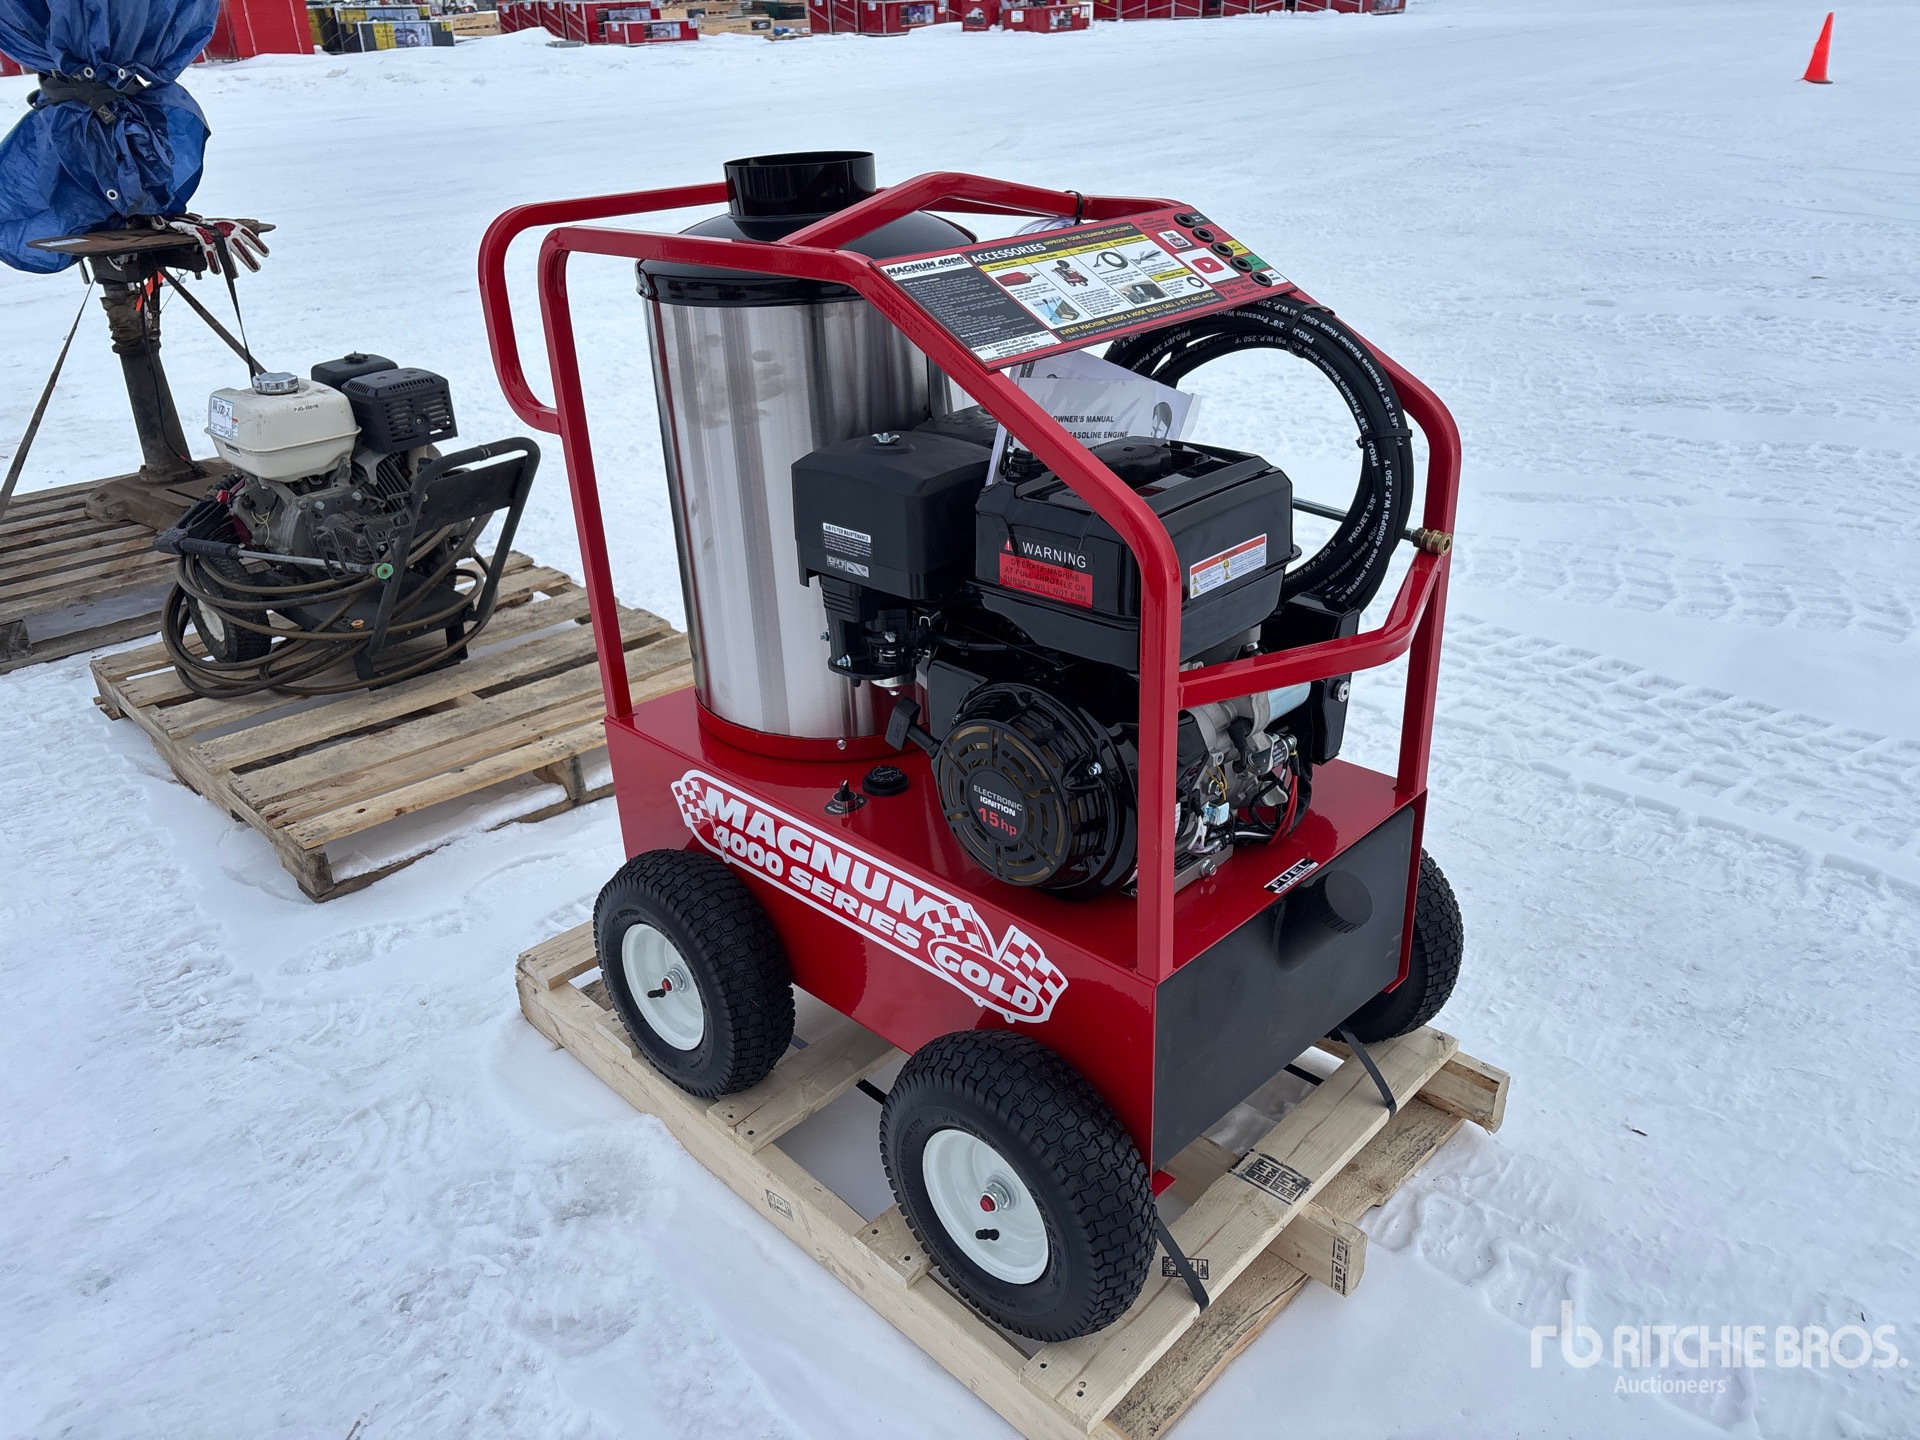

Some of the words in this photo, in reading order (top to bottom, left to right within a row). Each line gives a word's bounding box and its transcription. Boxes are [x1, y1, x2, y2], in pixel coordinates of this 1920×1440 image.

[1081, 230, 1106, 239] CLEANING
[1106, 225, 1134, 234] EFFICIENCY
[971, 243, 1046, 263] ACCESSORIES
[886, 261, 936, 275] MAGNUM
[938, 256, 965, 266] 4000
[1060, 327, 1080, 335] EVERY
[1080, 320, 1108, 330] MACHINE
[1108, 315, 1127, 324] NEEDS
[1131, 308, 1146, 318] HOSE
[1162, 302, 1176, 310] CALL
[1236, 310, 1270, 324] Pressure
[1164, 330, 1192, 348] PROJET
[1320, 322, 1338, 338] Hose
[1304, 347, 1320, 361] Hose
[1338, 335, 1362, 360] Washer
[1320, 359, 1341, 383] Washer
[1362, 359, 1385, 393] Pressure
[1340, 381, 1362, 414] Pressure
[1053, 415, 1085, 423] OWNER'S
[1086, 415, 1114, 423] MANUAL
[1103, 431, 1130, 439] ENGINE
[1348, 513, 1370, 544] PROJET
[1022, 541, 1086, 568] WARNING
[1318, 548, 1332, 560] 250
[1346, 568, 1368, 596] Washer
[1364, 548, 1378, 570] Hose
[1375, 509, 1390, 548] 4500PSI
[1004, 566, 1014, 574] AT
[1016, 569, 1033, 579] FULL
[1035, 574, 1073, 590] THROTTLE
[1075, 584, 1086, 593] OR
[1010, 559, 1045, 572] OPERATE
[1048, 566, 1080, 582] MACHINE
[1003, 574, 1032, 587] BURNER
[1034, 582, 1051, 594] WILL
[1054, 587, 1068, 598] NOT
[1070, 592, 1088, 603] FIRE
[974, 784, 1022, 812] ELECTRONIC
[980, 796, 1016, 816] IGNITION
[978, 807, 998, 828] 15
[1001, 818, 1018, 836] hp
[705, 786, 941, 922] MAGNUM
[713, 825, 784, 877] 4000
[788, 866, 922, 949] SERIES
[1271, 864, 1310, 888] FUEL
[934, 945, 1038, 1013] GOLD
